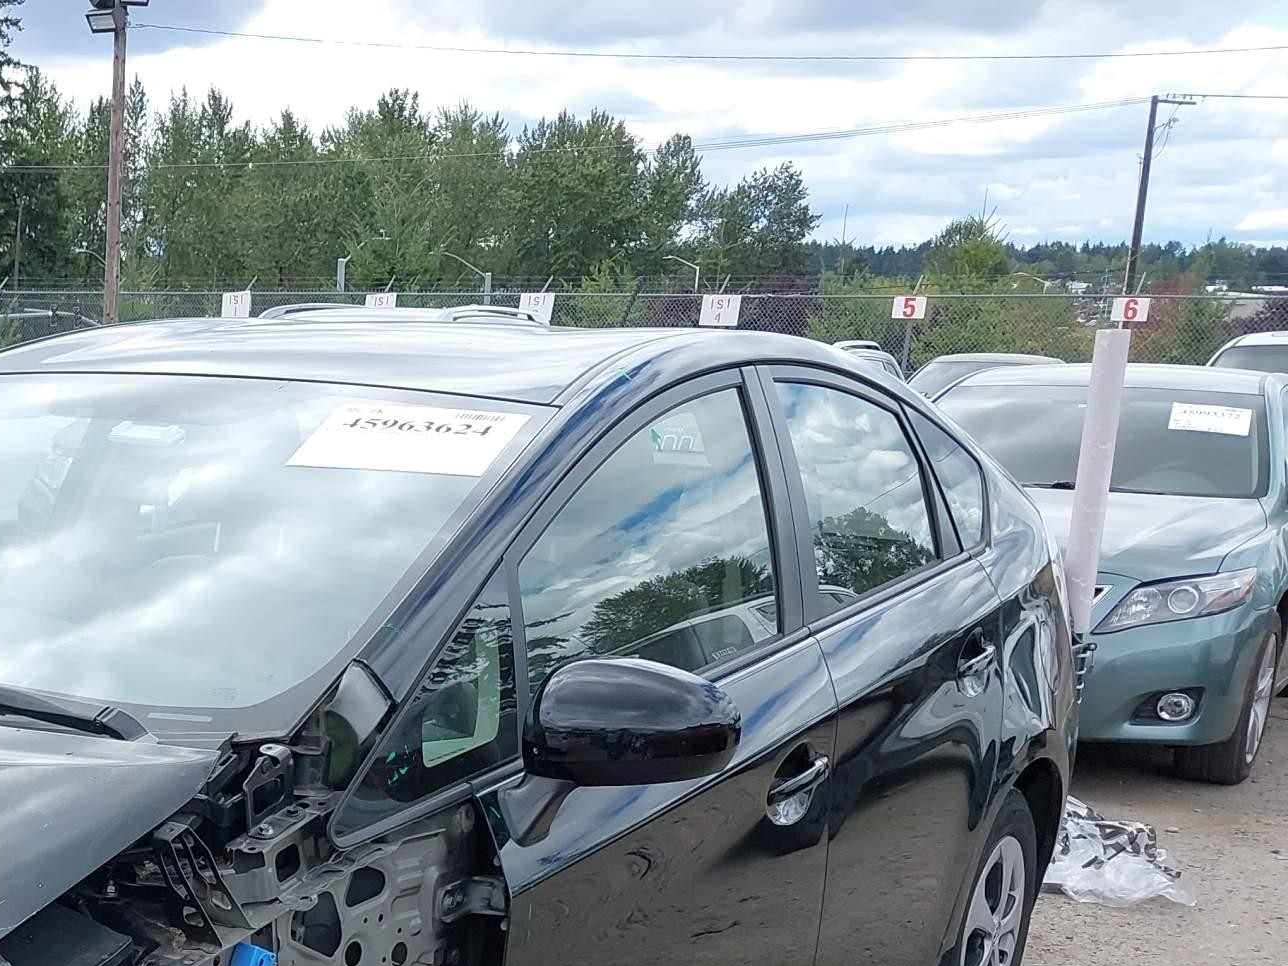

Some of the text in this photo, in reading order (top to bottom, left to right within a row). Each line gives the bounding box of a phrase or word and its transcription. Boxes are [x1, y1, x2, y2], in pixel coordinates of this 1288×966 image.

[902, 297, 916, 317] 5
[1123, 299, 1139, 320] 6
[342, 416, 493, 436] 45963624
